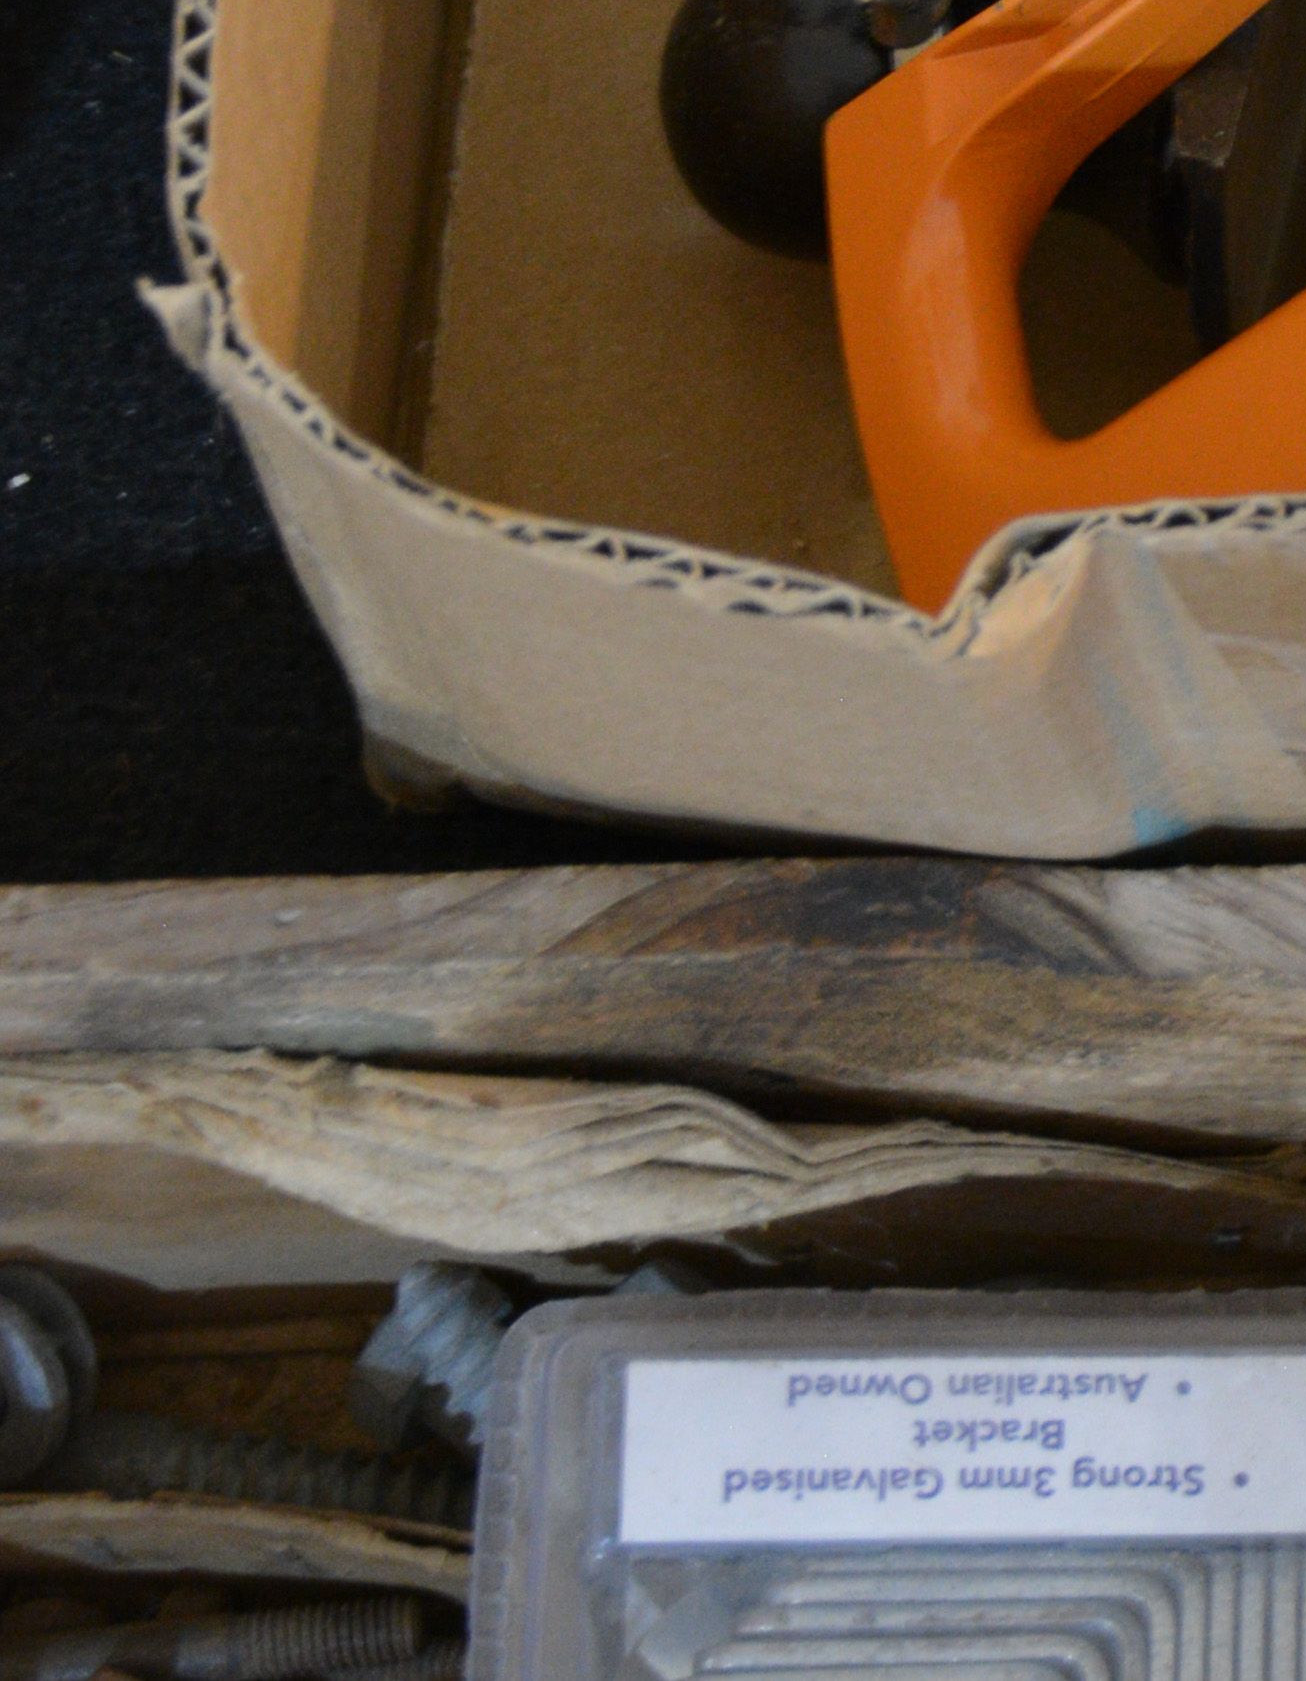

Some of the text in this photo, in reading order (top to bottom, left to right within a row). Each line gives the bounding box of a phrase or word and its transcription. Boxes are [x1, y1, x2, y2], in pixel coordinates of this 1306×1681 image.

[786, 1372, 1149, 1406] Australian Owned
[913, 1418, 1066, 1451] Bracket
[723, 1456, 1205, 1502] Strong 3mm Galvanised
